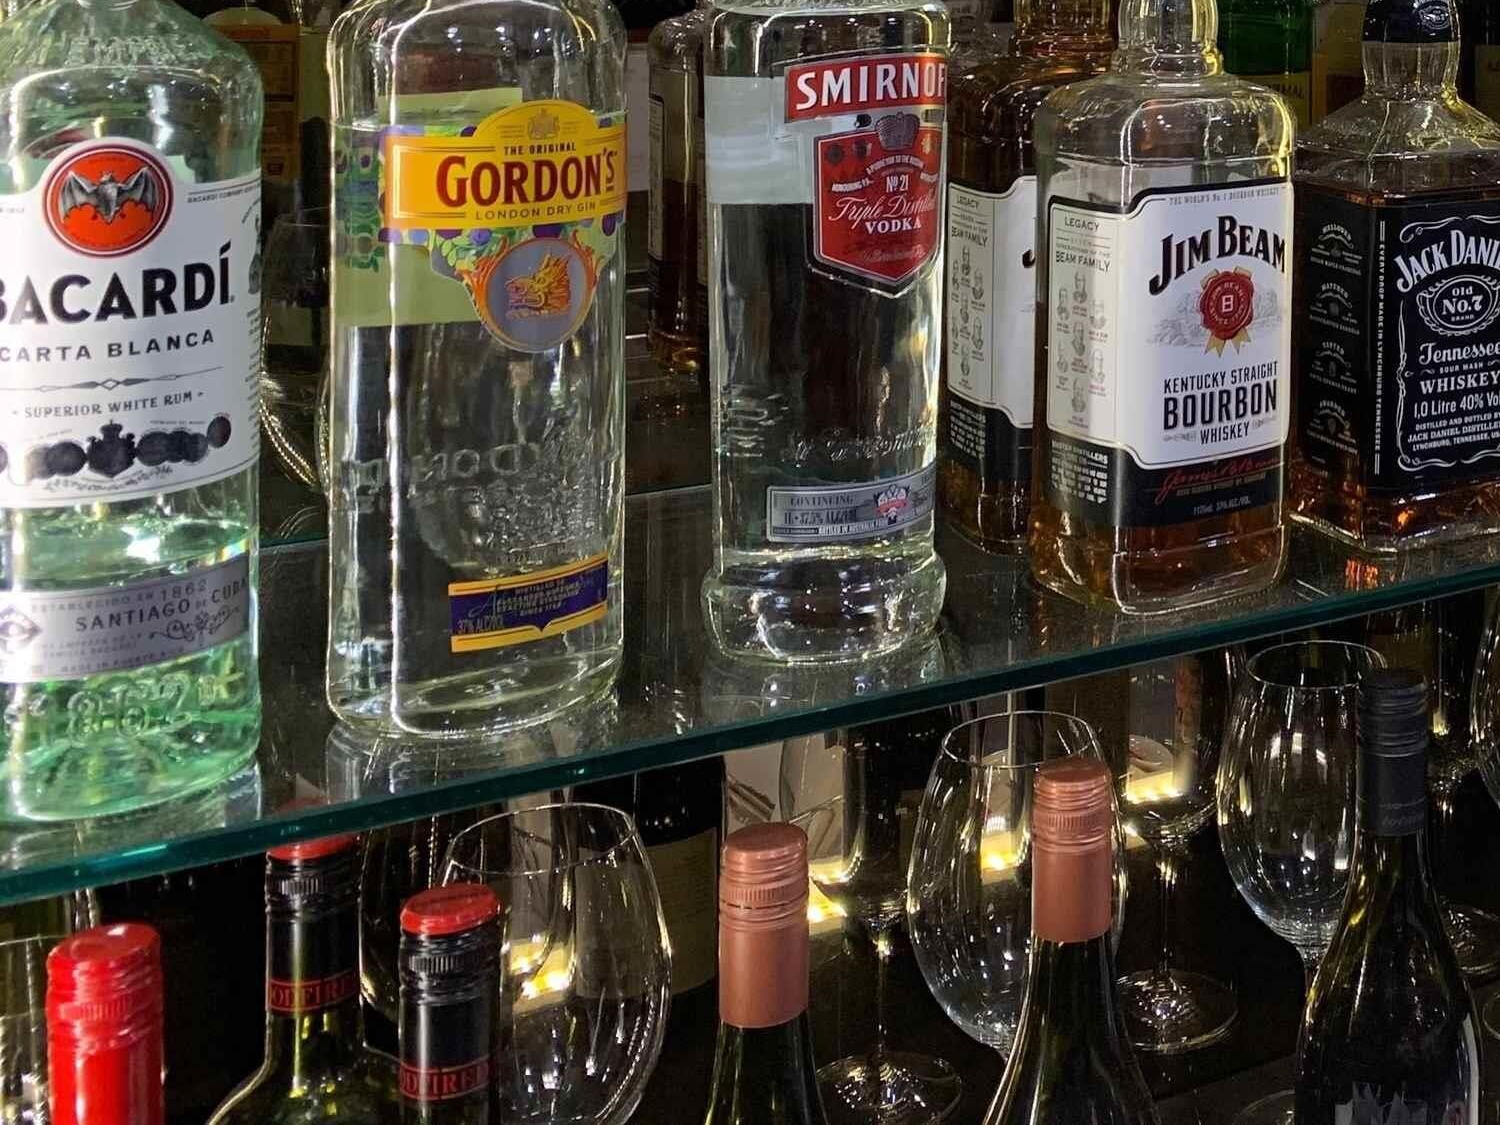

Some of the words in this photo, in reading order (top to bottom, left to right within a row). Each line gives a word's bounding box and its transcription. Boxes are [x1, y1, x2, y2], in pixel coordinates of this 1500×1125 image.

[504, 145, 524, 155] THE
[529, 141, 577, 155] ORIGINAL
[436, 148, 618, 208] GORDON'S
[474, 208, 541, 221] LONDON
[546, 205, 572, 216] DRY
[577, 202, 597, 213] GIN
[829, 196, 882, 230] Triple
[882, 192, 937, 218] Distilled
[956, 196, 981, 209] LEGACY
[866, 221, 923, 234] VODKA
[1064, 215, 1100, 233] LEGACY
[965, 231, 988, 248] FAMILY
[1056, 249, 1075, 264] BEAM
[1076, 254, 1112, 273] FAMILY
[1149, 225, 1212, 295] JIM
[1216, 214, 1286, 274] BEAM
[1378, 243, 1386, 274] EVERY
[1395, 241, 1448, 293] JACK
[1378, 275, 1386, 300] DROP
[1452, 287, 1474, 297] Old
[1377, 301, 1385, 325] MADE
[1441, 294, 1483, 316] No.7
[1451, 314, 1475, 322] BRAND
[0, 345, 91, 363] CARTA
[107, 328, 214, 359] BLANCA
[1376, 329, 1385, 340] IN
[1164, 369, 1227, 394] KENTUCKY
[1231, 361, 1279, 383] STRAIGHT
[1375, 341, 1384, 396] LYNCHBURG
[1439, 366, 1460, 375] SOUR
[1462, 363, 1485, 372] MASH
[24, 402, 102, 418] SUPERIOR
[107, 397, 159, 413] WHITE
[164, 391, 193, 408] RUM
[1163, 382, 1279, 431] BOURBON
[1413, 403, 1430, 419] 1,0
[1432, 399, 1458, 416] Litre
[1460, 395, 1485, 411] 40%
[1374, 398, 1383, 451] TENNESSEE
[1415, 420, 1447, 431] DISTILLED
[1449, 418, 1463, 427] AND
[1464, 413, 1493, 425] BOTTLED
[1199, 424, 1252, 445] WHISKEY
[1406, 430, 1431, 444] JACK
[1432, 427, 1460, 441] DANIEL
[1412, 439, 1451, 452] LYNCHBURG,
[1452, 433, 1490, 446] TENNESSEE,
[160, 579, 208, 600] 1862
[74, 598, 190, 633] SANTIAGO
[211, 578, 248, 605] CUBA
